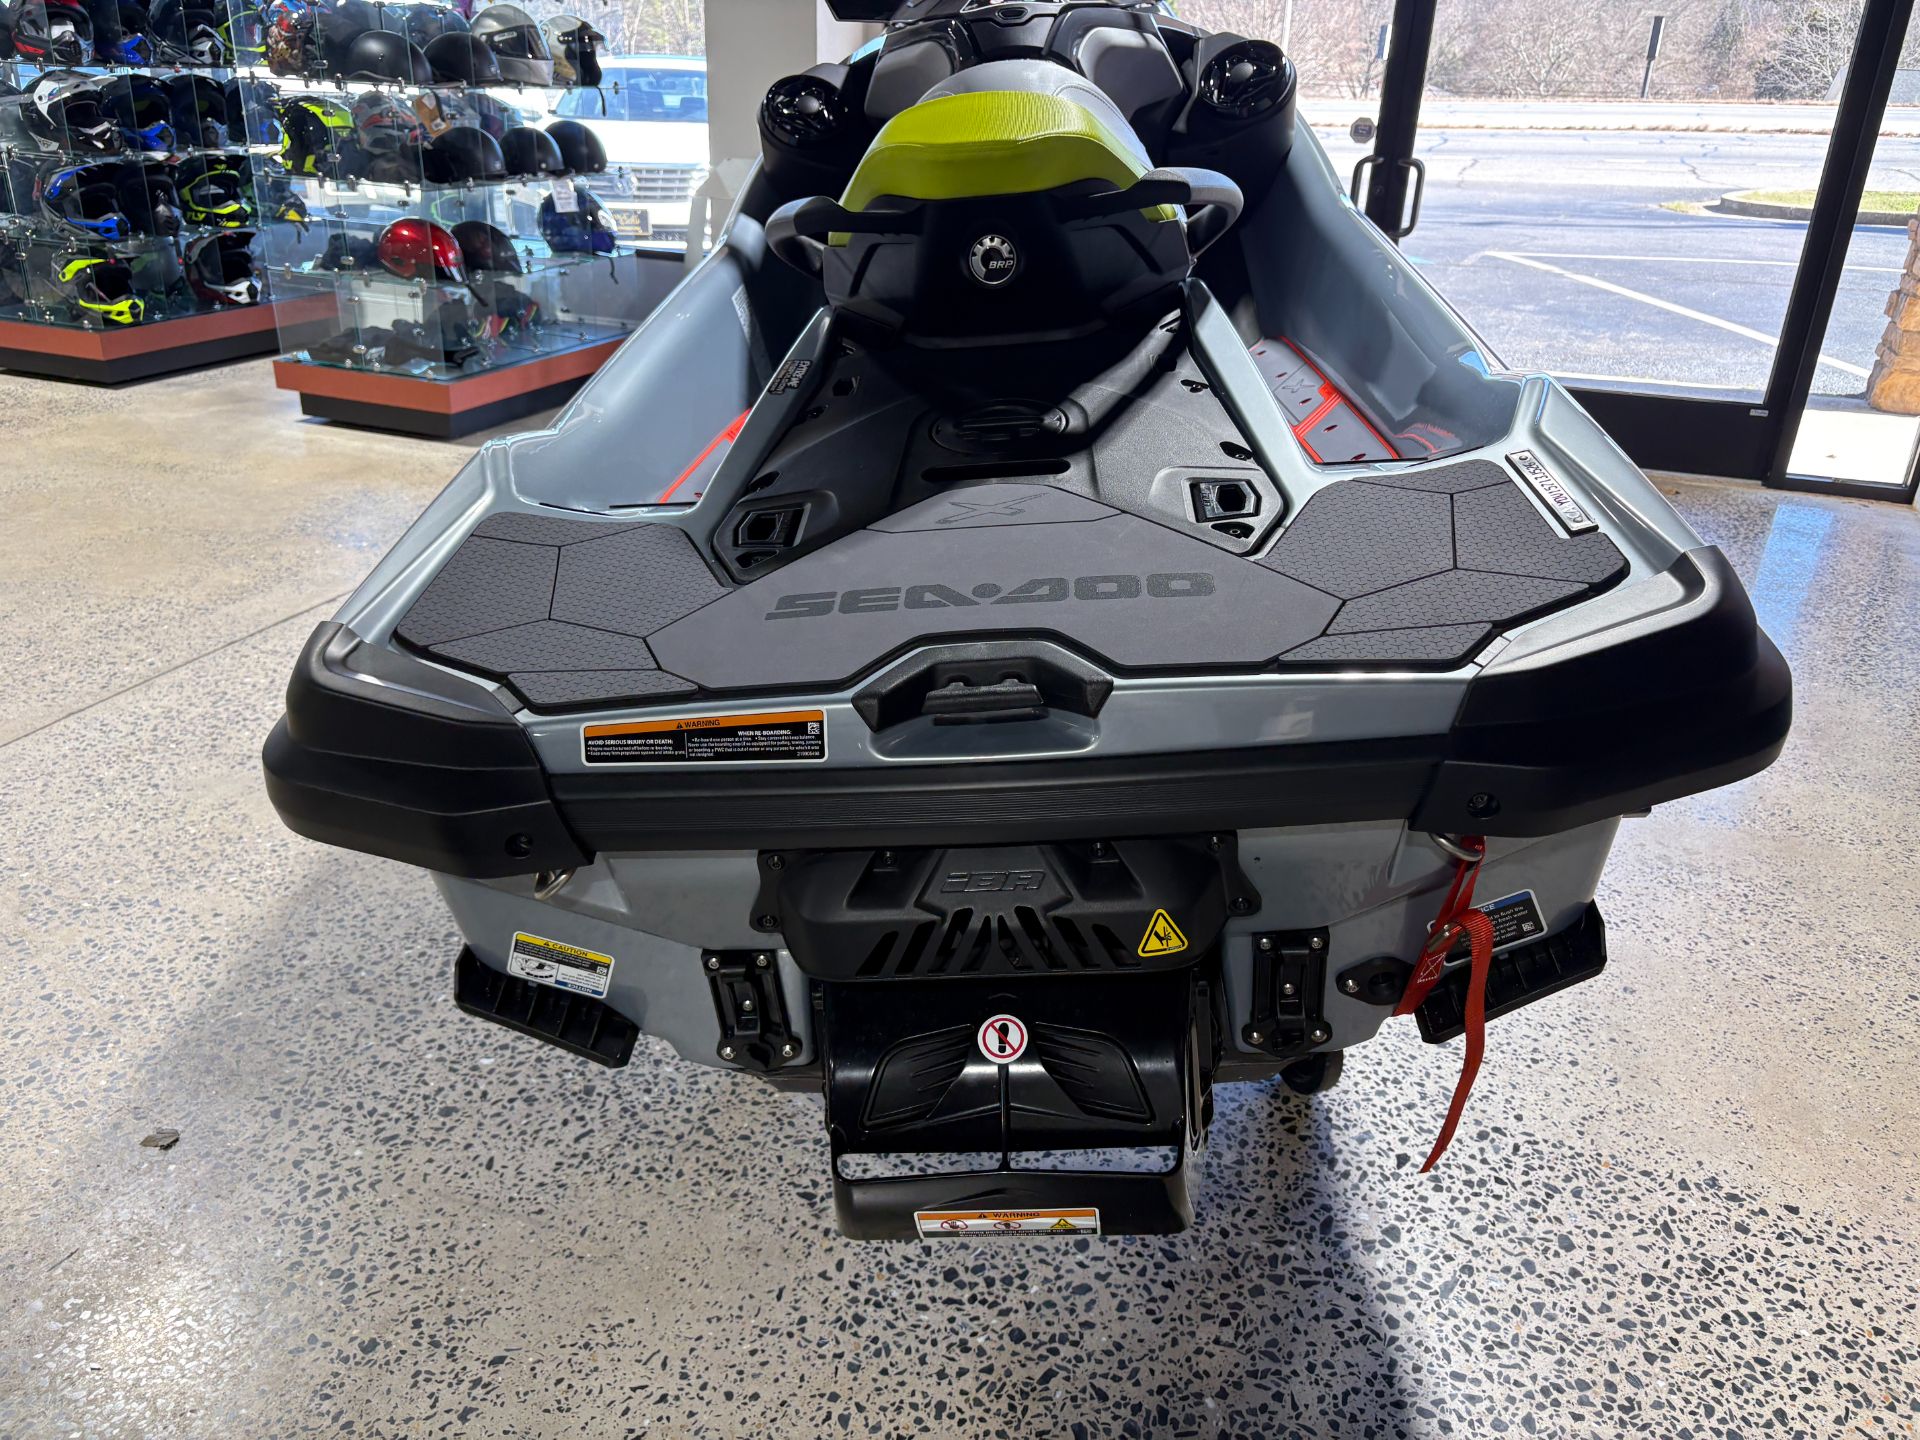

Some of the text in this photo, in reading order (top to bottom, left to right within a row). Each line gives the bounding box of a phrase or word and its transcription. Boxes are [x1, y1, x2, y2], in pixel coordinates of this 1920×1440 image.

[988, 260, 1014, 269] BRP
[684, 719, 720, 728] WARNING
[552, 942, 588, 957] CAUTION
